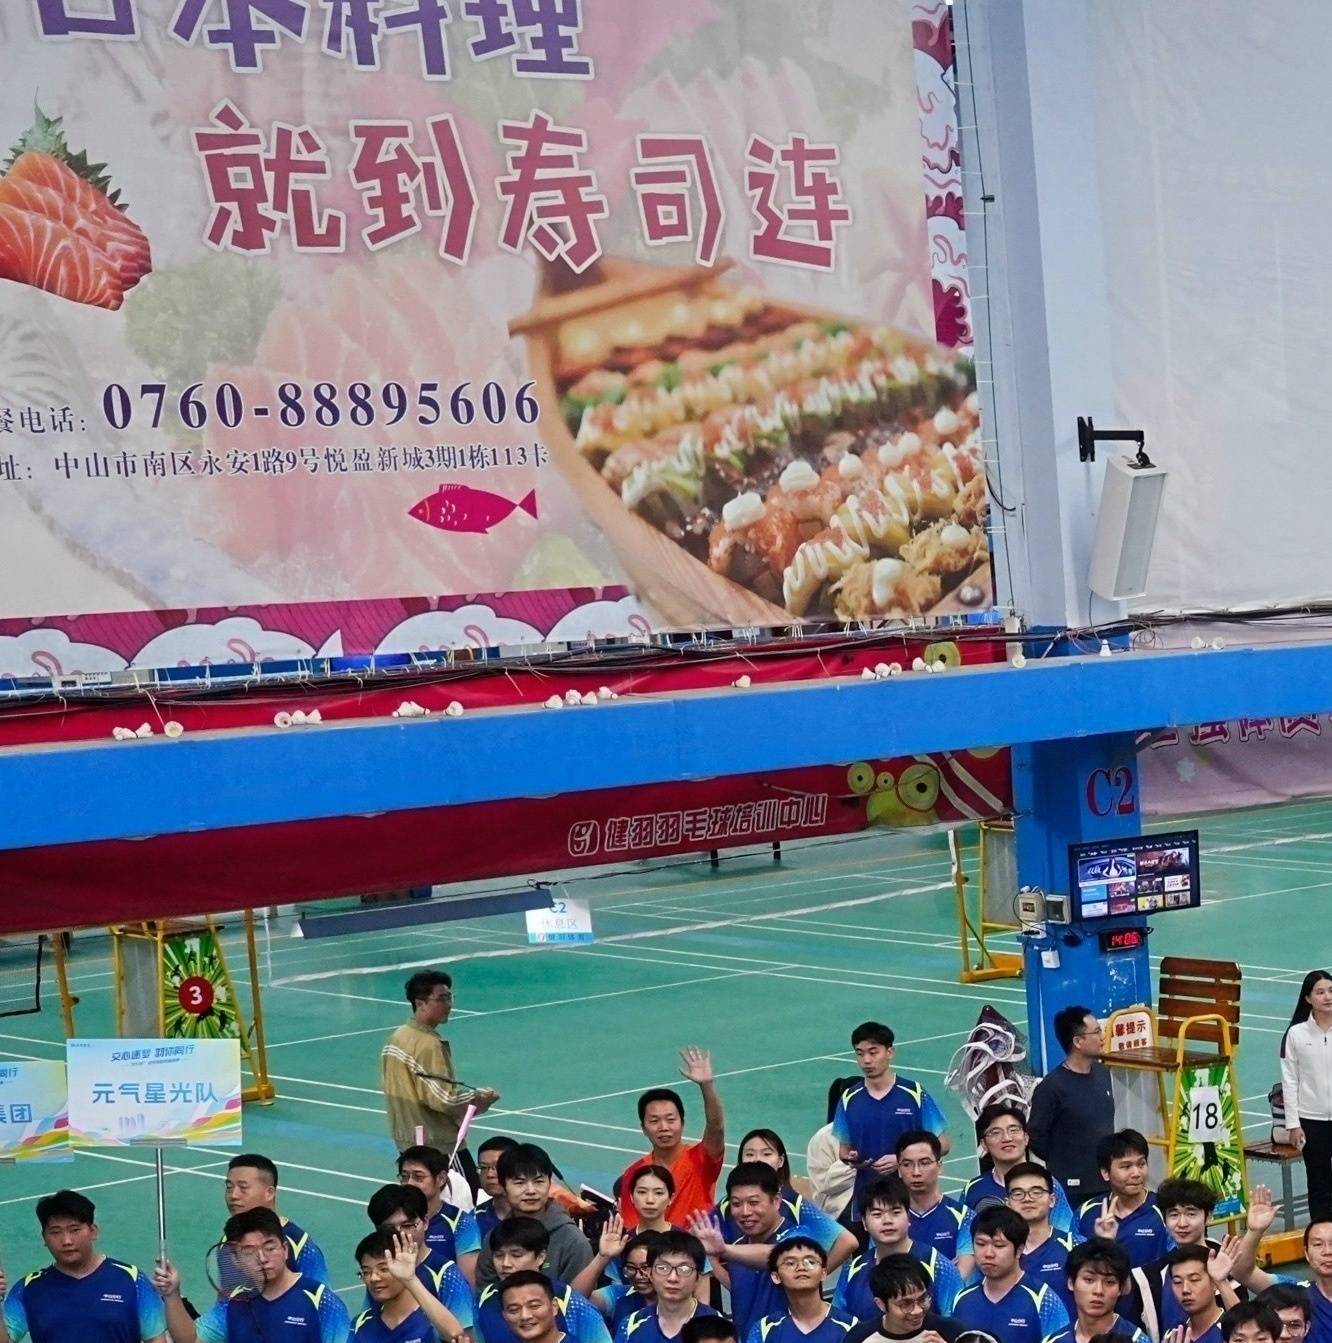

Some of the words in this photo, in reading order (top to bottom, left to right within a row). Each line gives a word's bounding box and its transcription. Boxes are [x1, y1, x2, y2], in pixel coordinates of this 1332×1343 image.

[39, 0, 592, 77] 本料理
[194, 100, 850, 273] 就到寿司连
[103, 381, 539, 430] 0760-88895606
[1087, 767, 1135, 816] C2
[604, 793, 828, 852] 健羽羽毛球培训中心
[188, 985, 203, 1005] 3
[92, 1083, 219, 1105] 元气星光队
[1193, 1102, 1219, 1130] 18
